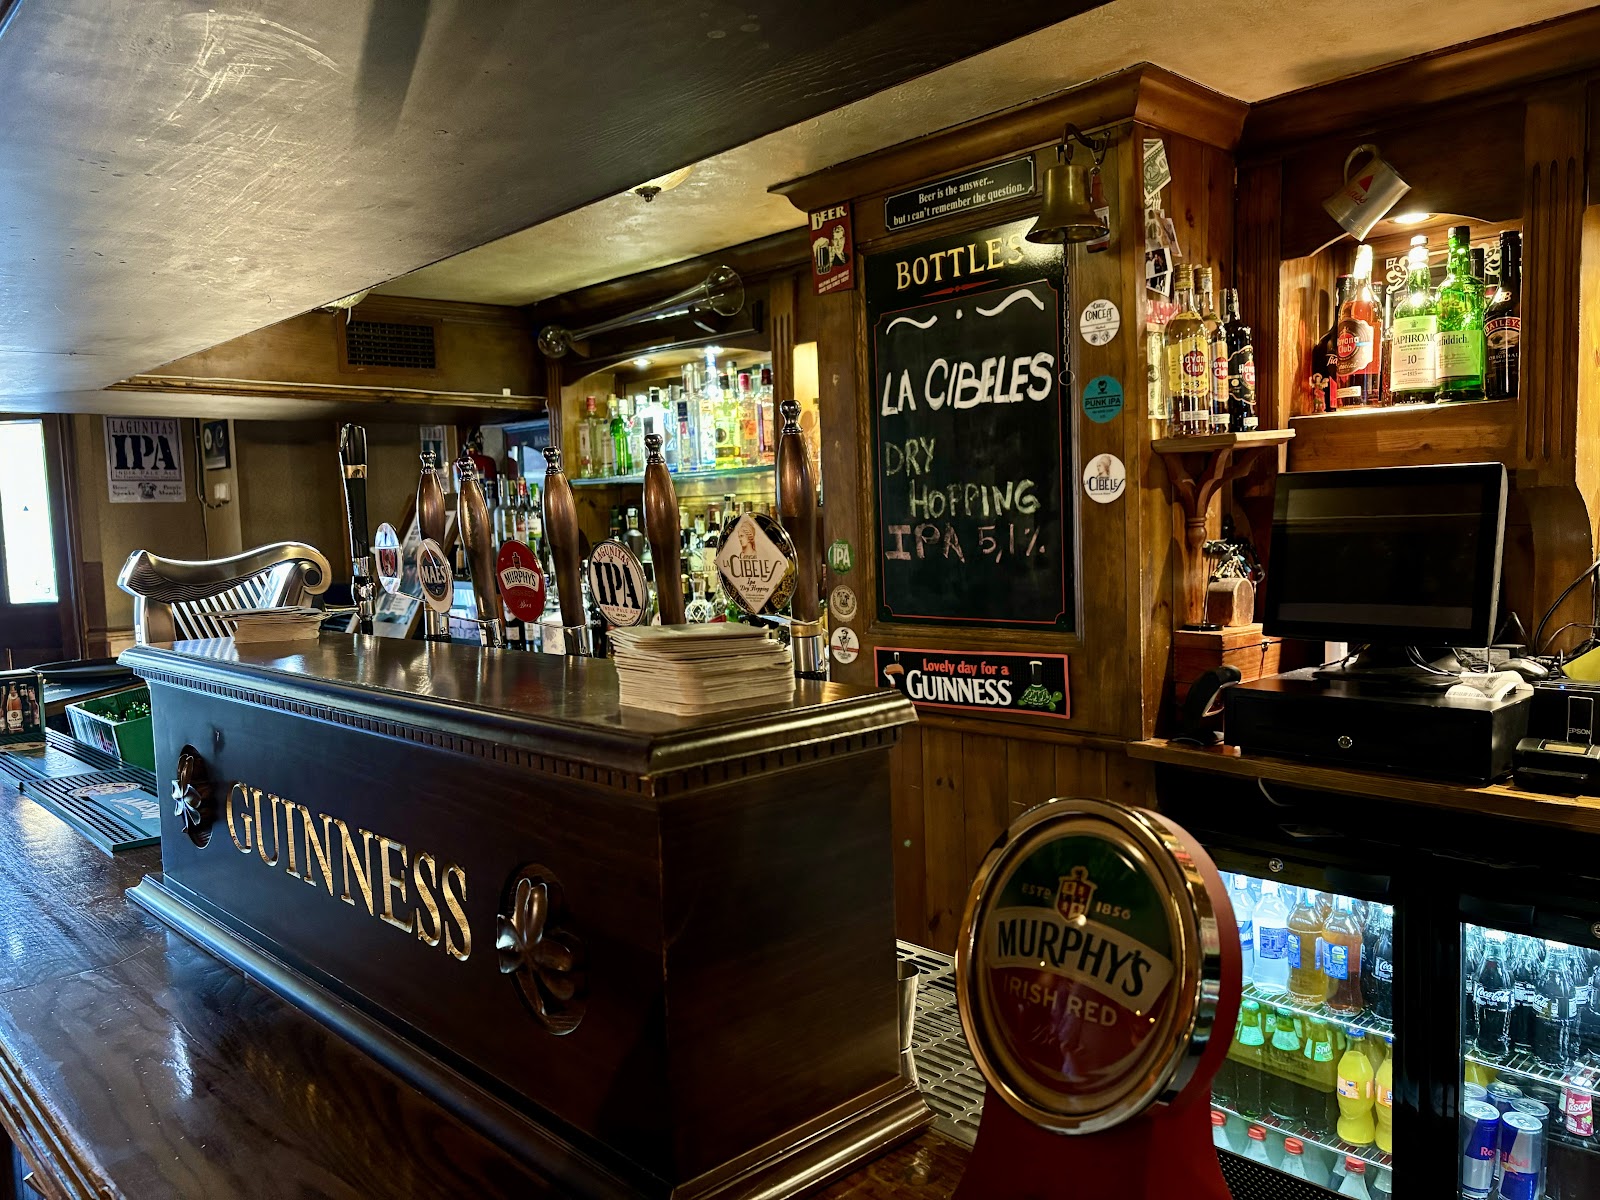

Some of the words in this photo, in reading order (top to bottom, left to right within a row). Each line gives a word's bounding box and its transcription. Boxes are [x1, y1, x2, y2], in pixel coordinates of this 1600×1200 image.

[893, 213, 906, 226] but
[912, 207, 930, 221] can't
[931, 197, 971, 216] remember
[972, 192, 987, 204] the
[987, 181, 1025, 202] question.
[918, 191, 936, 204] Beer
[937, 188, 944, 199] is
[945, 185, 958, 196] the
[959, 175, 994, 193] answer...
[811, 205, 848, 231] BEER
[896, 234, 1025, 290] BOTTLES
[1407, 354, 1417, 365] 10
[881, 368, 917, 417] LA
[924, 351, 1055, 411] CIBELES
[1085, 399, 1107, 408] PUNK
[1108, 397, 1121, 406] IPA
[112, 420, 174, 434] LAGUNITAS
[112, 434, 177, 470] IPA
[884, 436, 935, 476] DRY
[1088, 476, 1125, 493] CIBELES
[593, 544, 630, 566] LAGUNITAS
[884, 522, 966, 563] IPA
[729, 554, 782, 583] CIBELES
[833, 548, 851, 567] IPA
[420, 565, 447, 585] MAES
[592, 561, 641, 610] IPA
[922, 658, 956, 675] Lovely
[957, 660, 978, 677] day
[980, 660, 998, 675] for
[1000, 665, 1010, 676] a
[905, 669, 1012, 706] GUINNESS
[1568, 727, 1591, 735] EPSON
[226, 781, 472, 961] GUINNESS
[1095, 901, 1132, 920] 1856
[997, 919, 1152, 997] MURPHY'S
[1003, 974, 1058, 1009] IRISH
[1067, 994, 1118, 1027] RED
